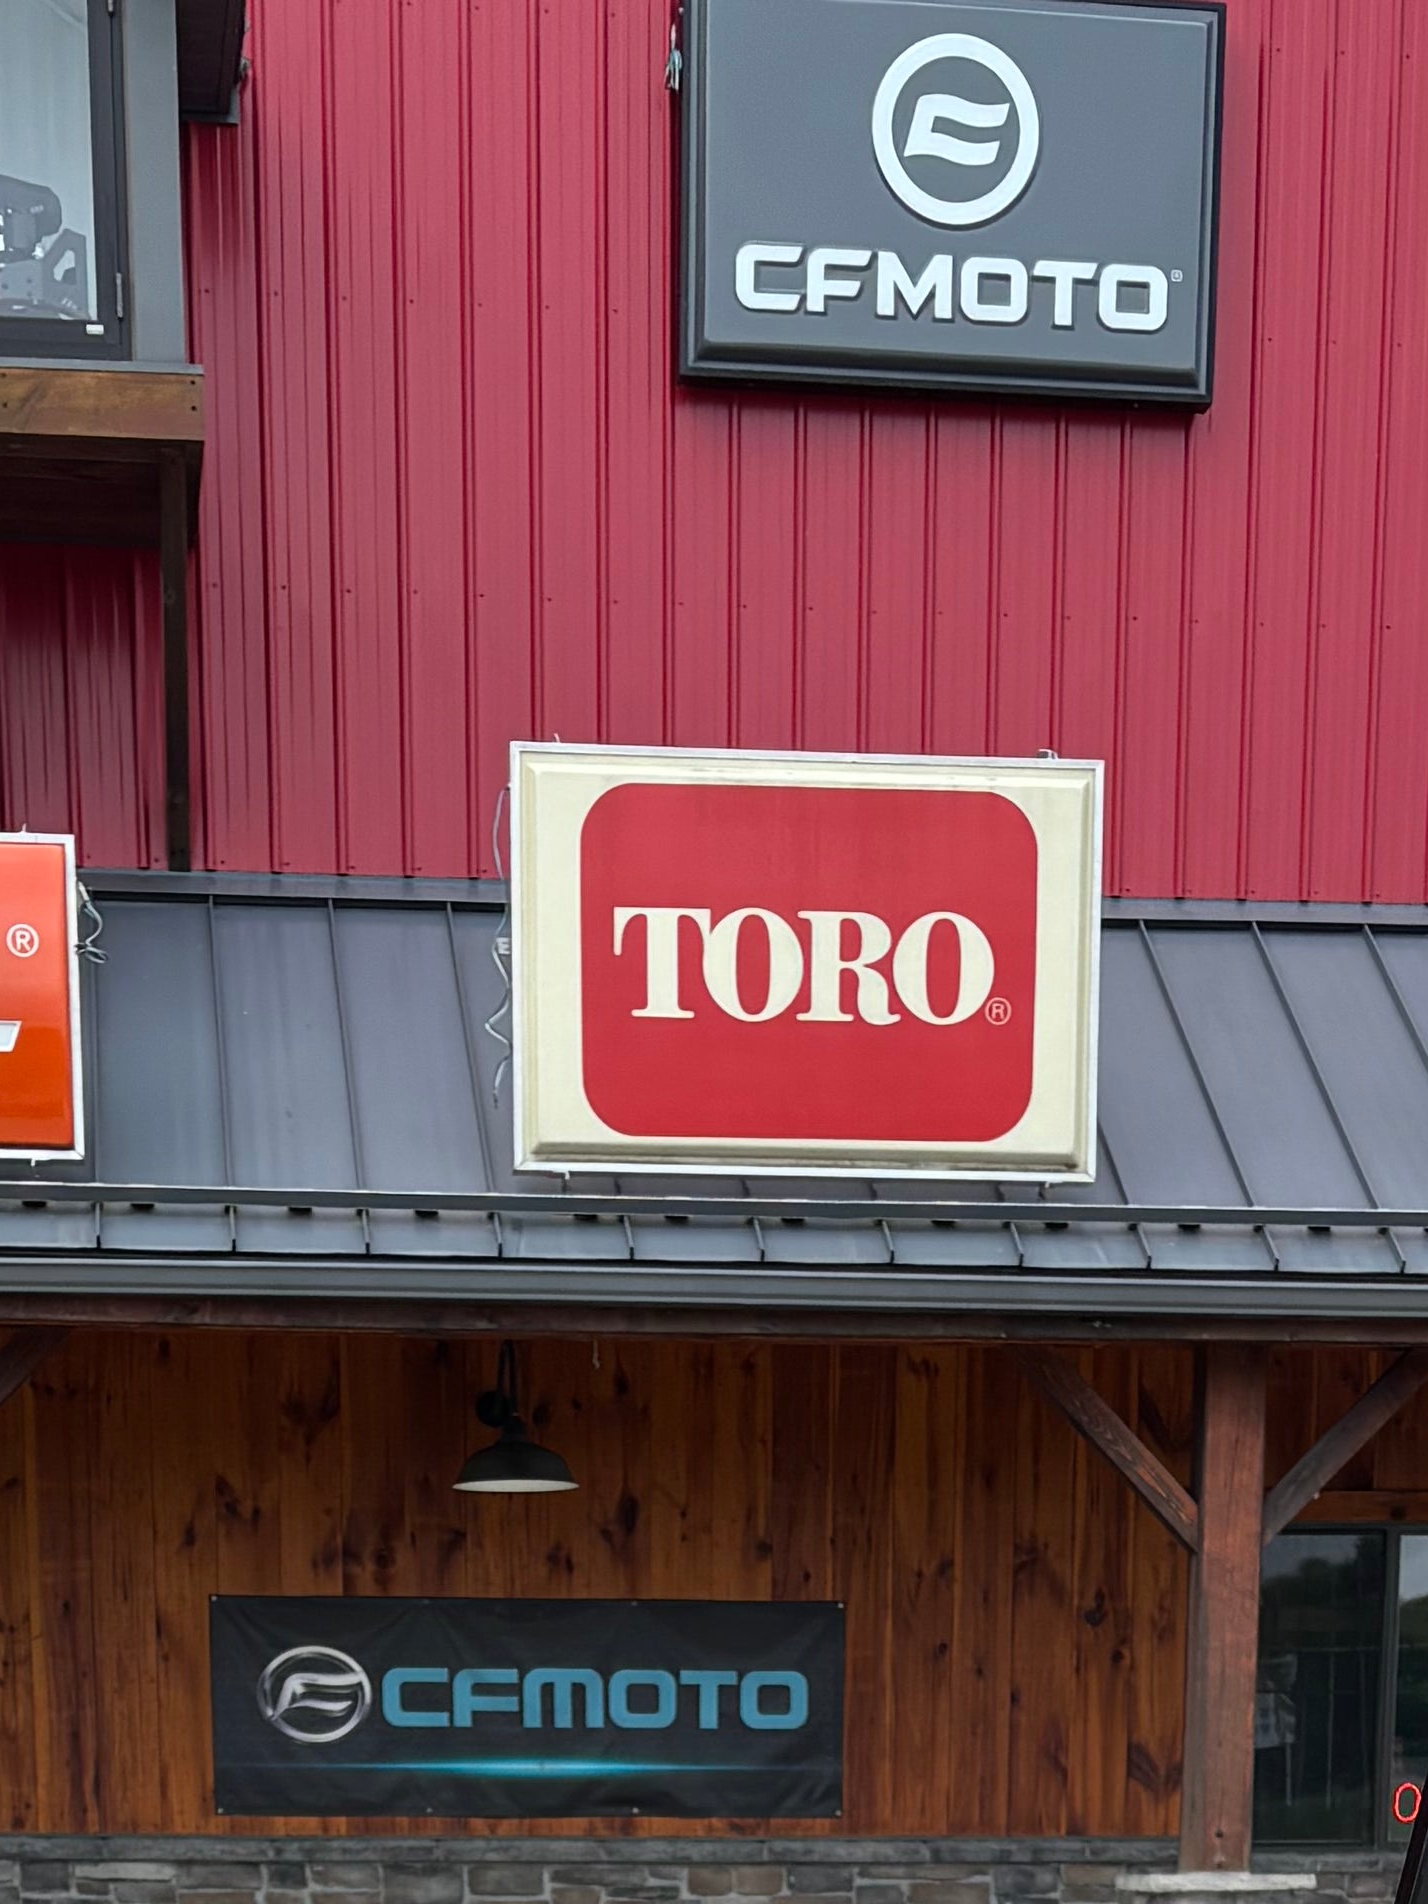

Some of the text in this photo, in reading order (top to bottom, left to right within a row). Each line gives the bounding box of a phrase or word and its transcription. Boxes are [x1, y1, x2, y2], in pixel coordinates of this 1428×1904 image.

[735, 241, 1169, 332] CFMOTO
[613, 906, 996, 1026] TORO
[381, 1666, 810, 1731] CFMOTO
